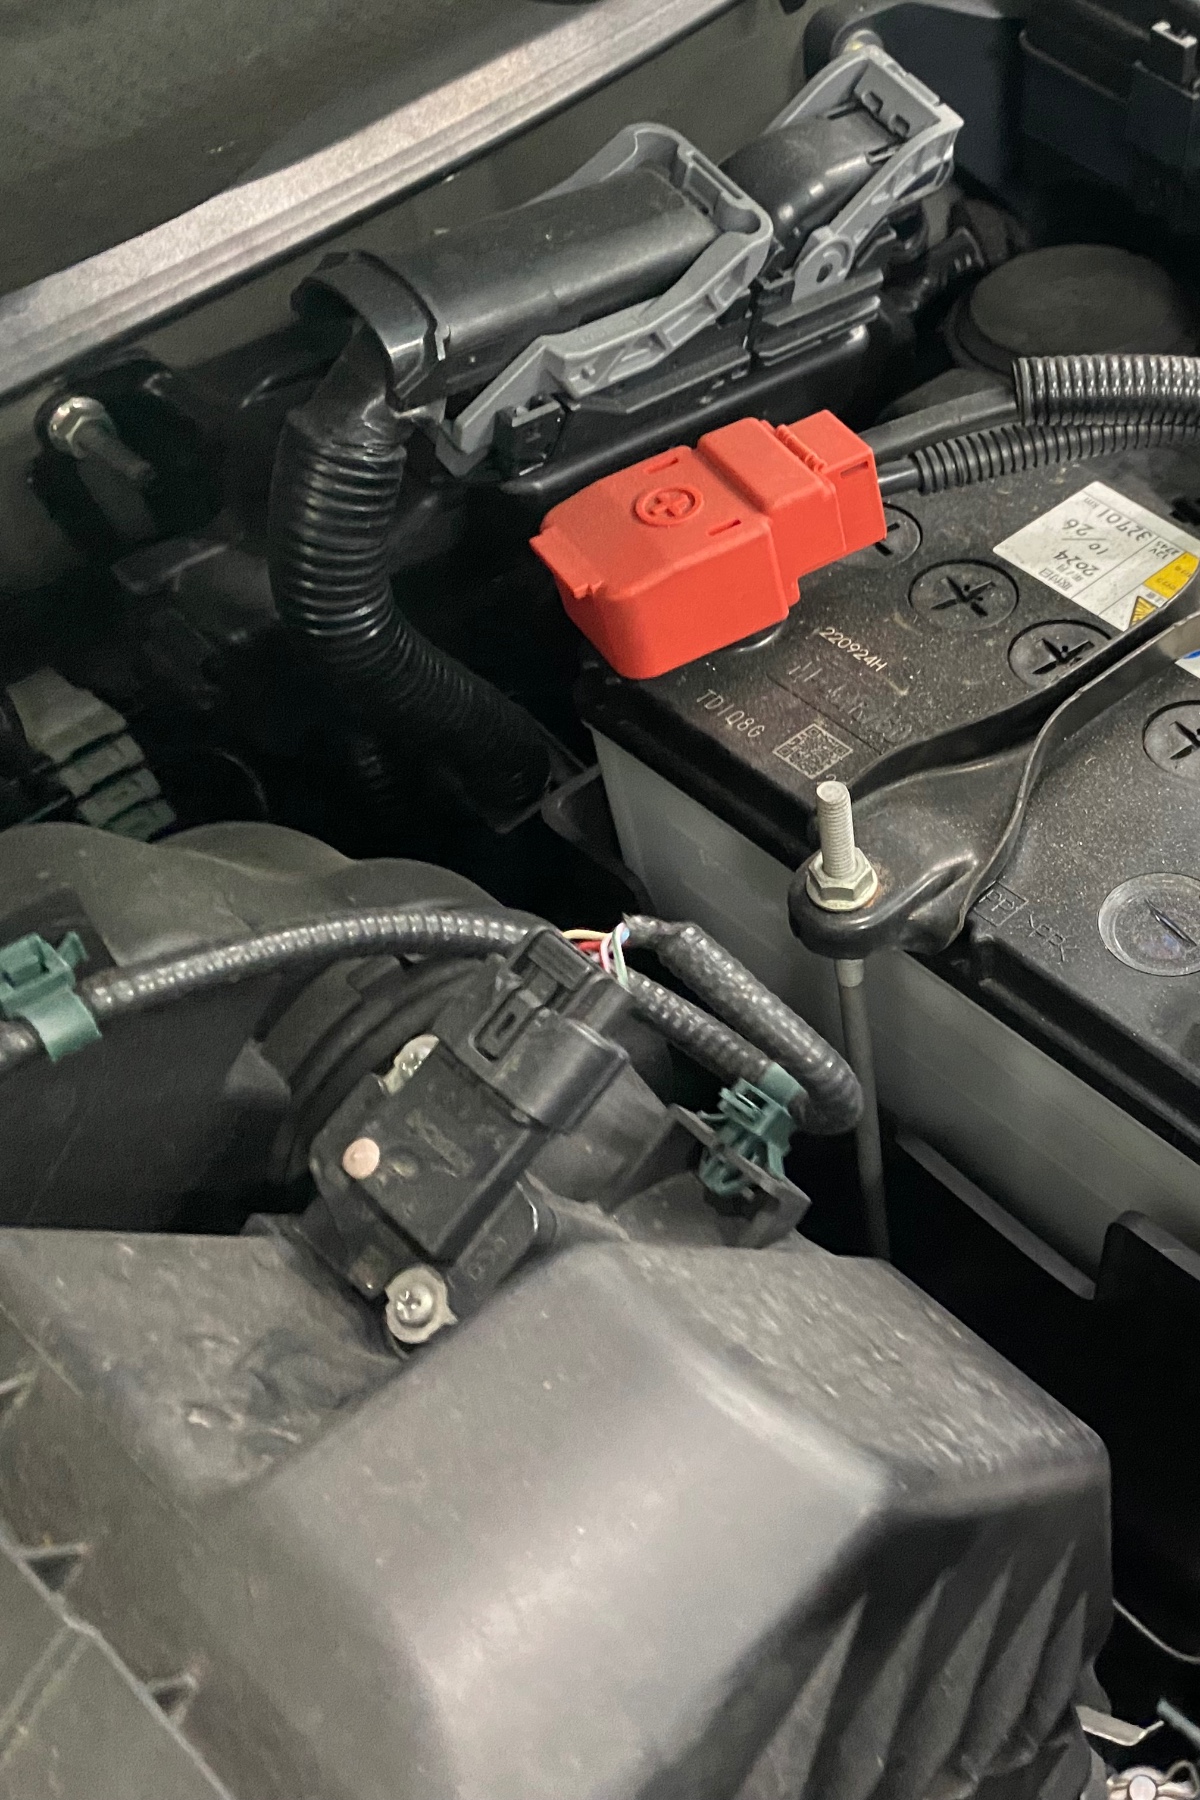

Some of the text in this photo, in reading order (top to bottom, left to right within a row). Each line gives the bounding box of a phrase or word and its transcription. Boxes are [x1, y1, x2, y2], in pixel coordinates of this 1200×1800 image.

[1082, 496, 1100, 510] km
[1053, 546, 1099, 577] 2024
[818, 623, 888, 673] 220924H
